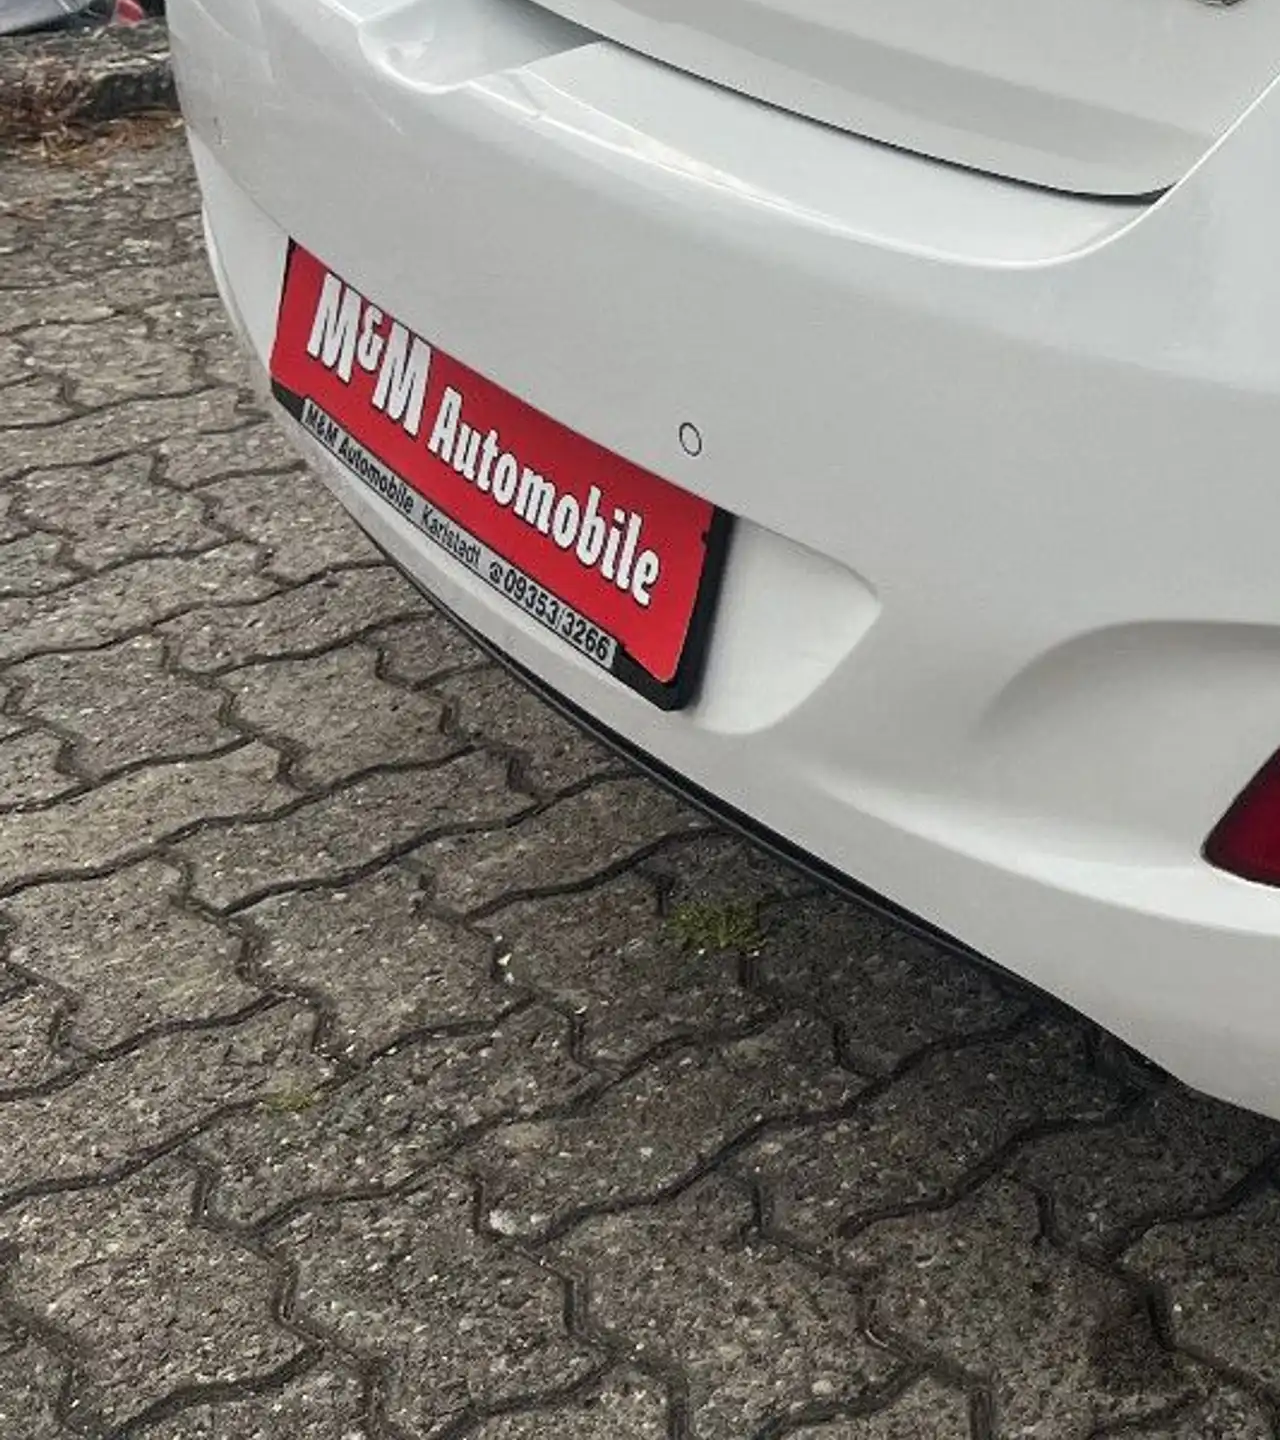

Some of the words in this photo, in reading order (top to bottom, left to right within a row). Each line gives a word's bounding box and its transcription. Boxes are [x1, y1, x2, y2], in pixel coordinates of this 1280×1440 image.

[305, 403, 339, 447] M&M
[338, 436, 414, 514] Automobile
[504, 570, 612, 662] 09353/3266
[307, 273, 432, 437] M&M
[428, 386, 659, 607] Automobile
